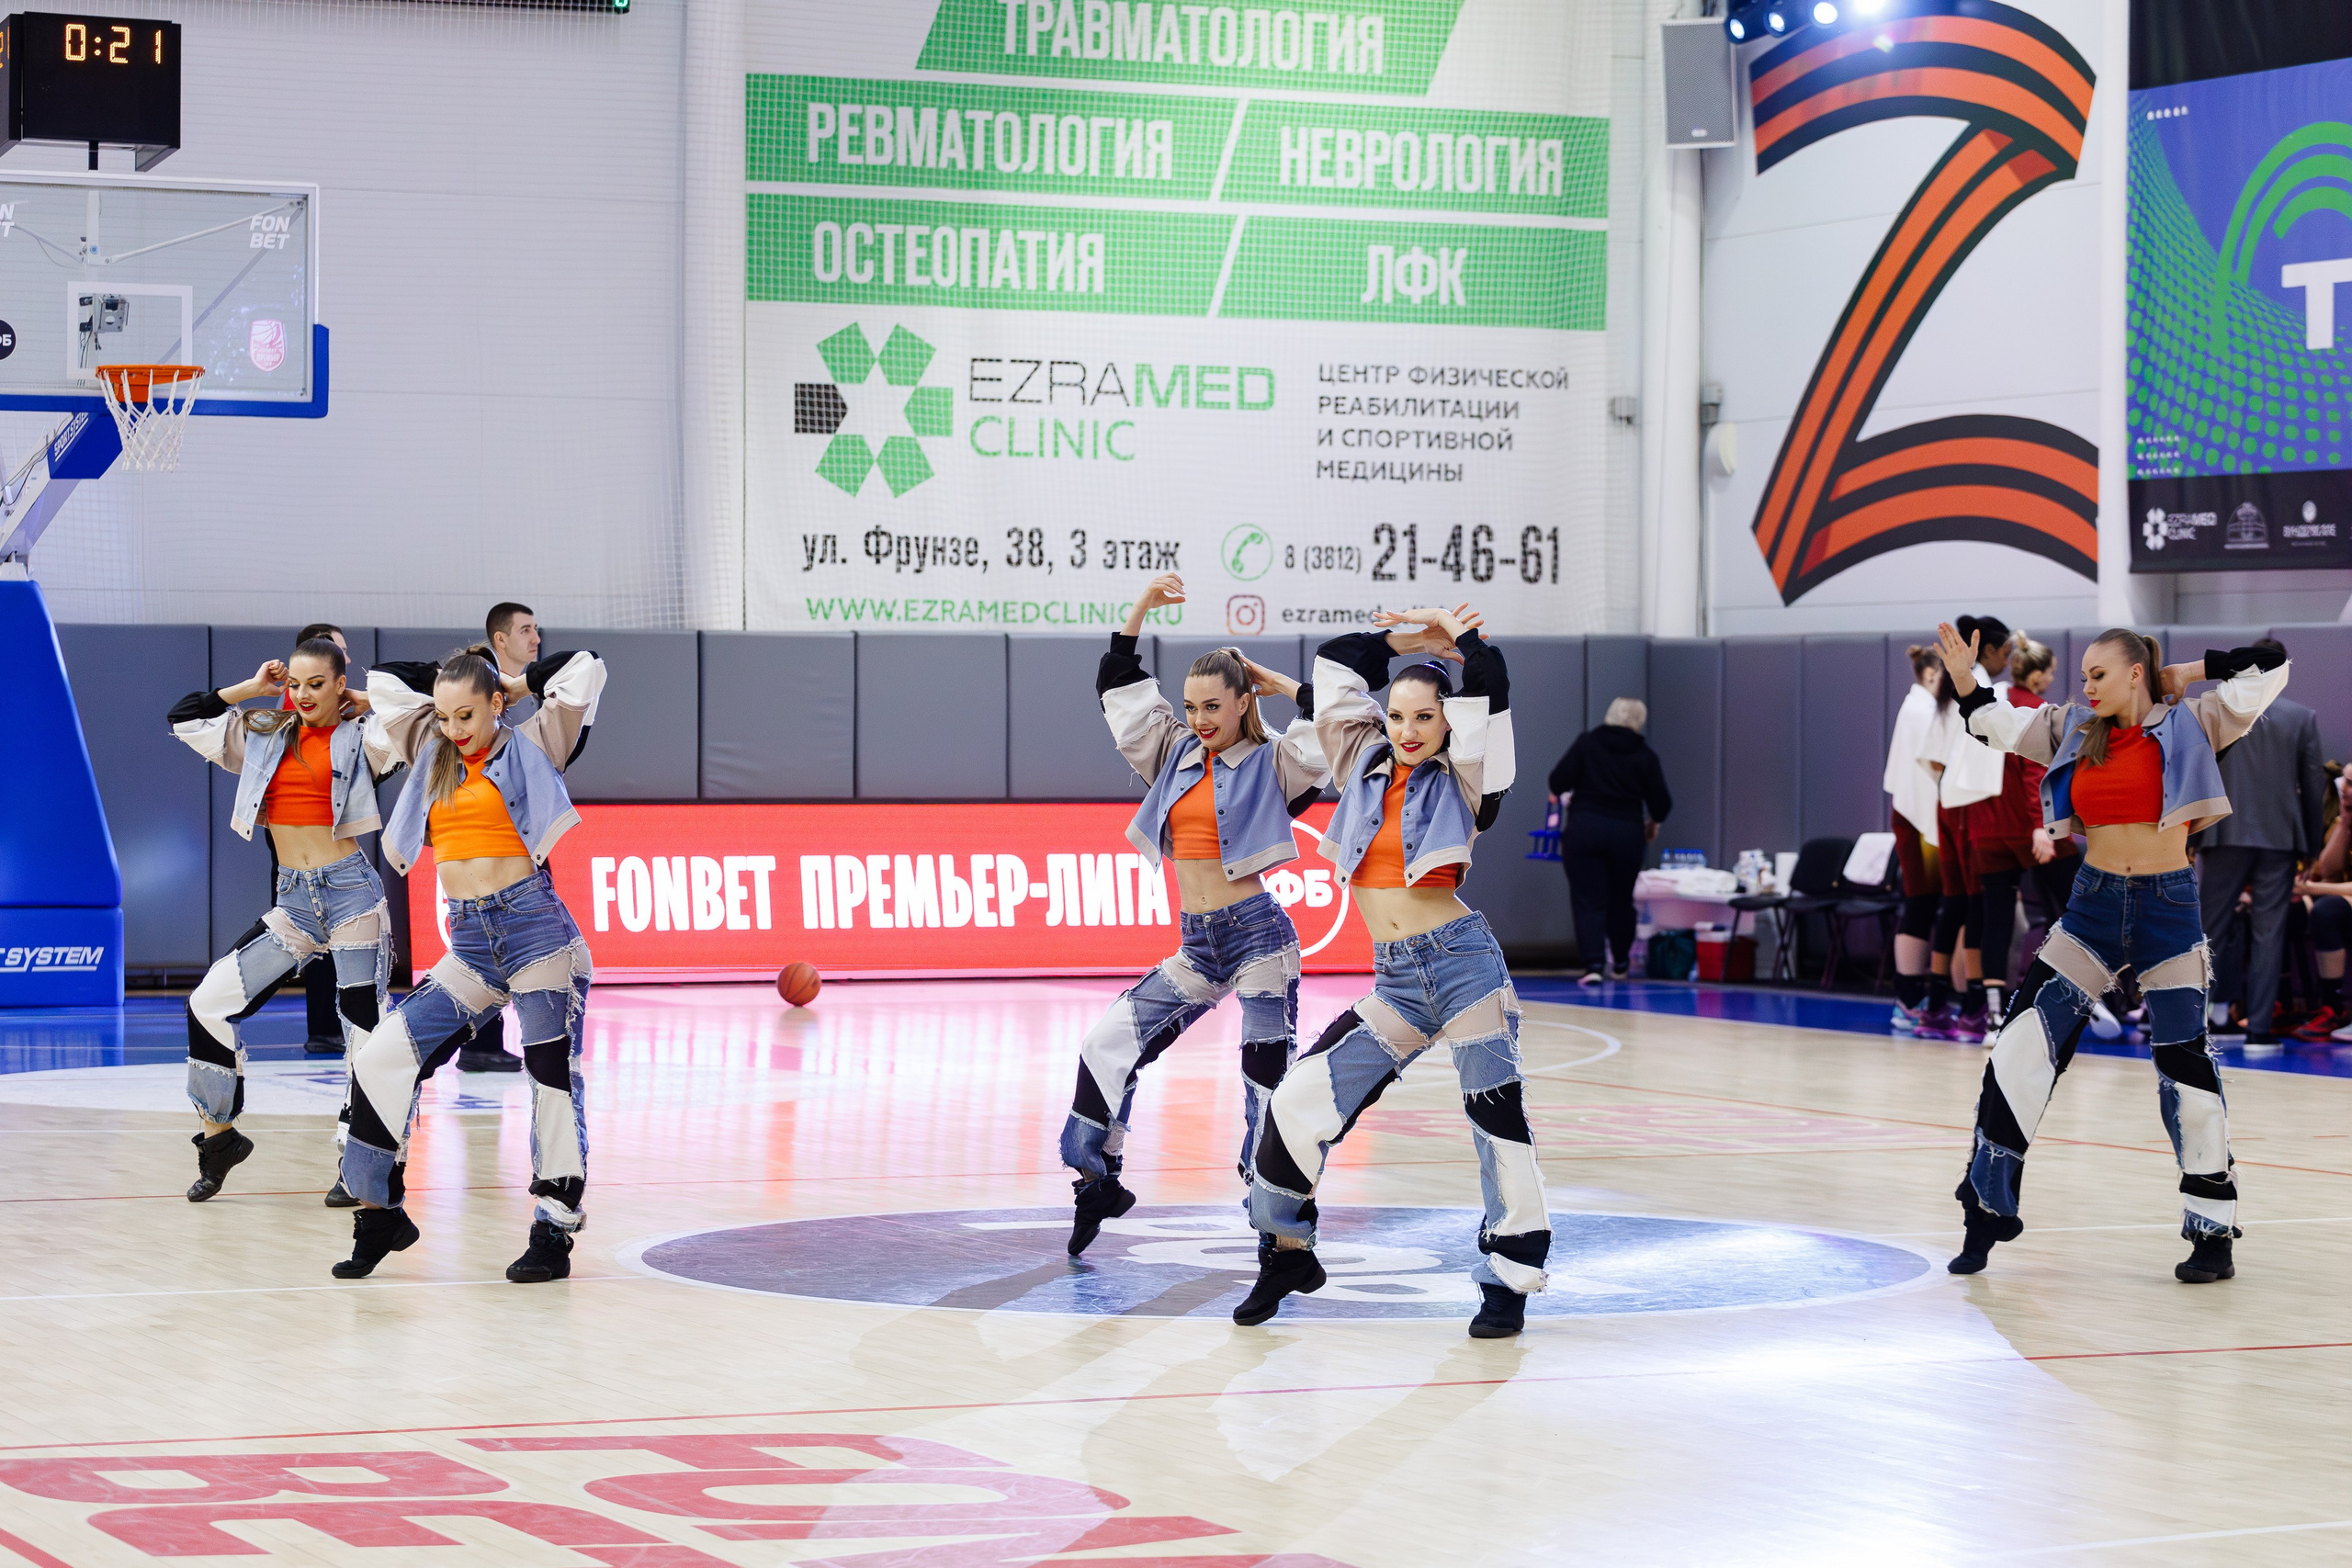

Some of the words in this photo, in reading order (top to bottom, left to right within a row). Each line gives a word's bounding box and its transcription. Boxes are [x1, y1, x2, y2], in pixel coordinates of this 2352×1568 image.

[65, 23, 162, 64] 0:21
[1002, 0, 1385, 75] ТРАВМАТОЛОГИЯ
[808, 101, 1174, 181] РЕВМАТОЛОГИЯ
[1279, 125, 1564, 197] НЕВРОЛОГИЯ
[250, 232, 289, 249] BET
[251, 216, 290, 231] FON
[813, 220, 1104, 294] ОСТЕОПАТИЯ
[1361, 243, 1467, 307] ЛФК
[969, 356, 1276, 412] EZRAMED
[1318, 363, 1400, 387] ЦЕНТР
[1408, 364, 1569, 390] ФИЗИЧЕСКОЙ
[1317, 395, 1521, 422] РЕАБИЛИТАЦИИ
[969, 415, 1136, 462] CLINIC
[1317, 428, 1333, 446] И
[1341, 426, 1513, 452] СПОРТИВНОЙ
[1316, 459, 1464, 483] МЕДИЦИНЫ
[801, 533, 848, 572] ул.
[863, 524, 989, 574] Фрунзе,
[1005, 525, 1054, 575] 38,
[1069, 527, 1088, 570] 3
[1102, 537, 1182, 571] этаж
[1284, 544, 1295, 570] 8
[1304, 544, 1363, 574] (3812)
[1371, 522, 1561, 586] 21-46-61
[806, 597, 1183, 626] WWW.EZRAMEDCLINICRU
[591, 855, 776, 932] FONBET
[800, 852, 1172, 930] ПРЕМЬЕР-ЛИГА
[1260, 869, 1334, 908] ФБ
[5, 946, 105, 973] SYSTEM
